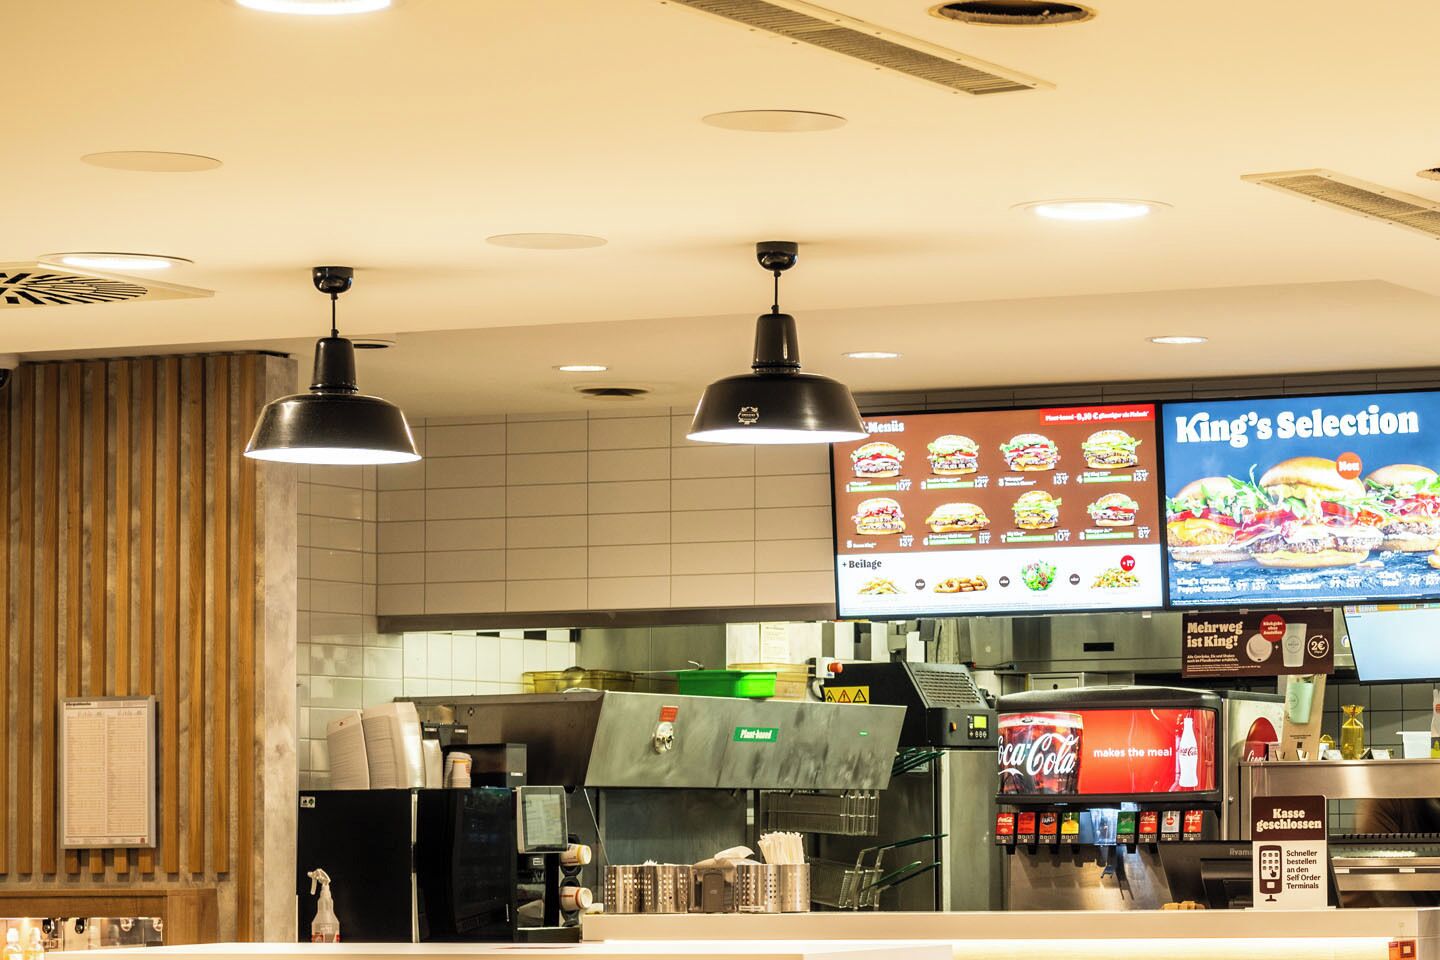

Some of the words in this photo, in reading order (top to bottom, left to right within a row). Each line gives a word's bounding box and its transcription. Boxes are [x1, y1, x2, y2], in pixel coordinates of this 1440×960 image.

[1176, 411, 1272, 448] King's
[1277, 404, 1419, 439] Selection
[848, 559, 882, 570] Beilage
[1187, 621, 1243, 635] Mehrweg
[1187, 635, 1202, 648] ist
[1204, 634, 1238, 649] King!
[1311, 641, 1325, 651] 2€
[740, 729, 773, 739] Plant-based
[1093, 747, 1125, 757] makes
[1128, 747, 1145, 757] the
[1147, 747, 1172, 757] meal
[1272, 808, 1305, 819] Kasse
[1256, 819, 1322, 832] geschlossen
